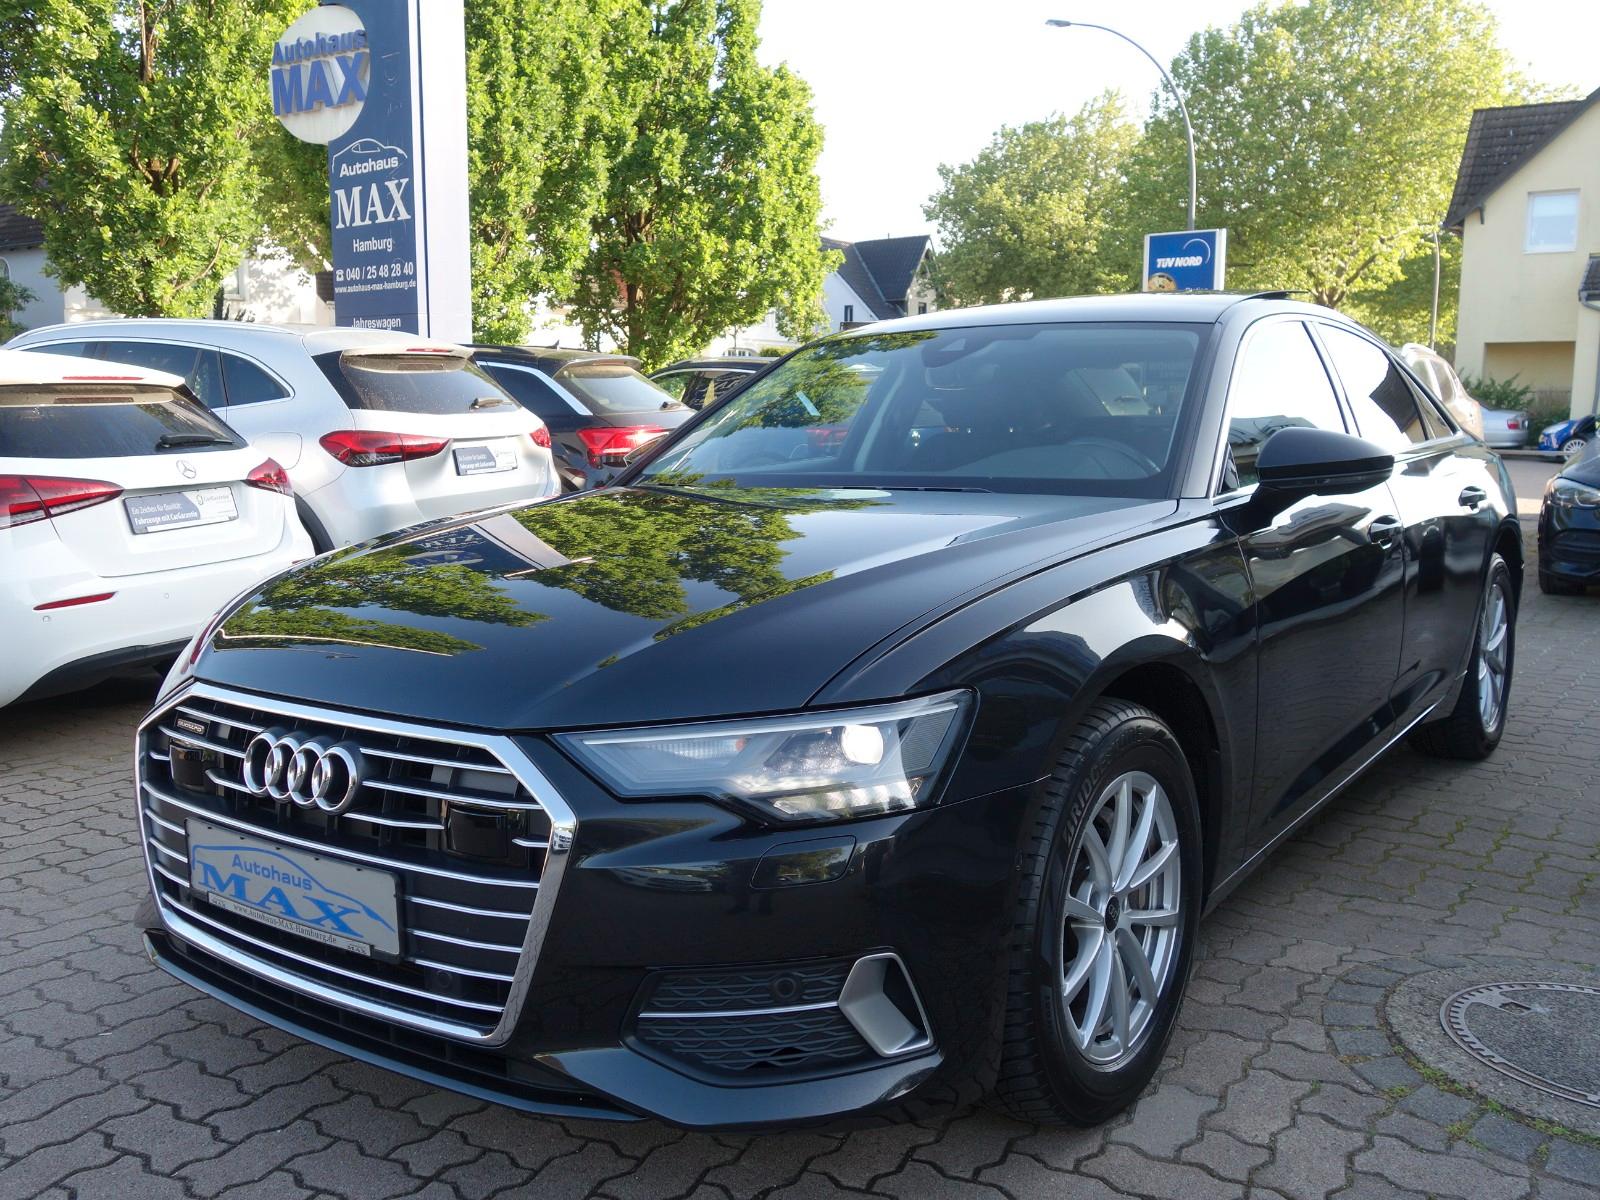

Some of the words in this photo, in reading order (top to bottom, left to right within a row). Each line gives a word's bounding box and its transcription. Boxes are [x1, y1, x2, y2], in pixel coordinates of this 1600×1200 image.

[272, 29, 368, 65] Autohaus
[272, 52, 367, 116] MAX
[340, 156, 398, 178] Autohaus
[334, 178, 411, 229] MAX
[352, 237, 392, 252] Hamburg
[346, 267, 360, 280] 040
[366, 266, 377, 279] 25
[378, 264, 389, 278] 48
[390, 263, 402, 277] 28
[403, 262, 414, 276] 40
[1174, 255, 1202, 268] NORD
[334, 280, 416, 293] www.autohaus-max-hamburg.de
[352, 317, 401, 330] Jahreswagen
[232, 854, 312, 891] Autohaus
[197, 860, 364, 938] MAX
